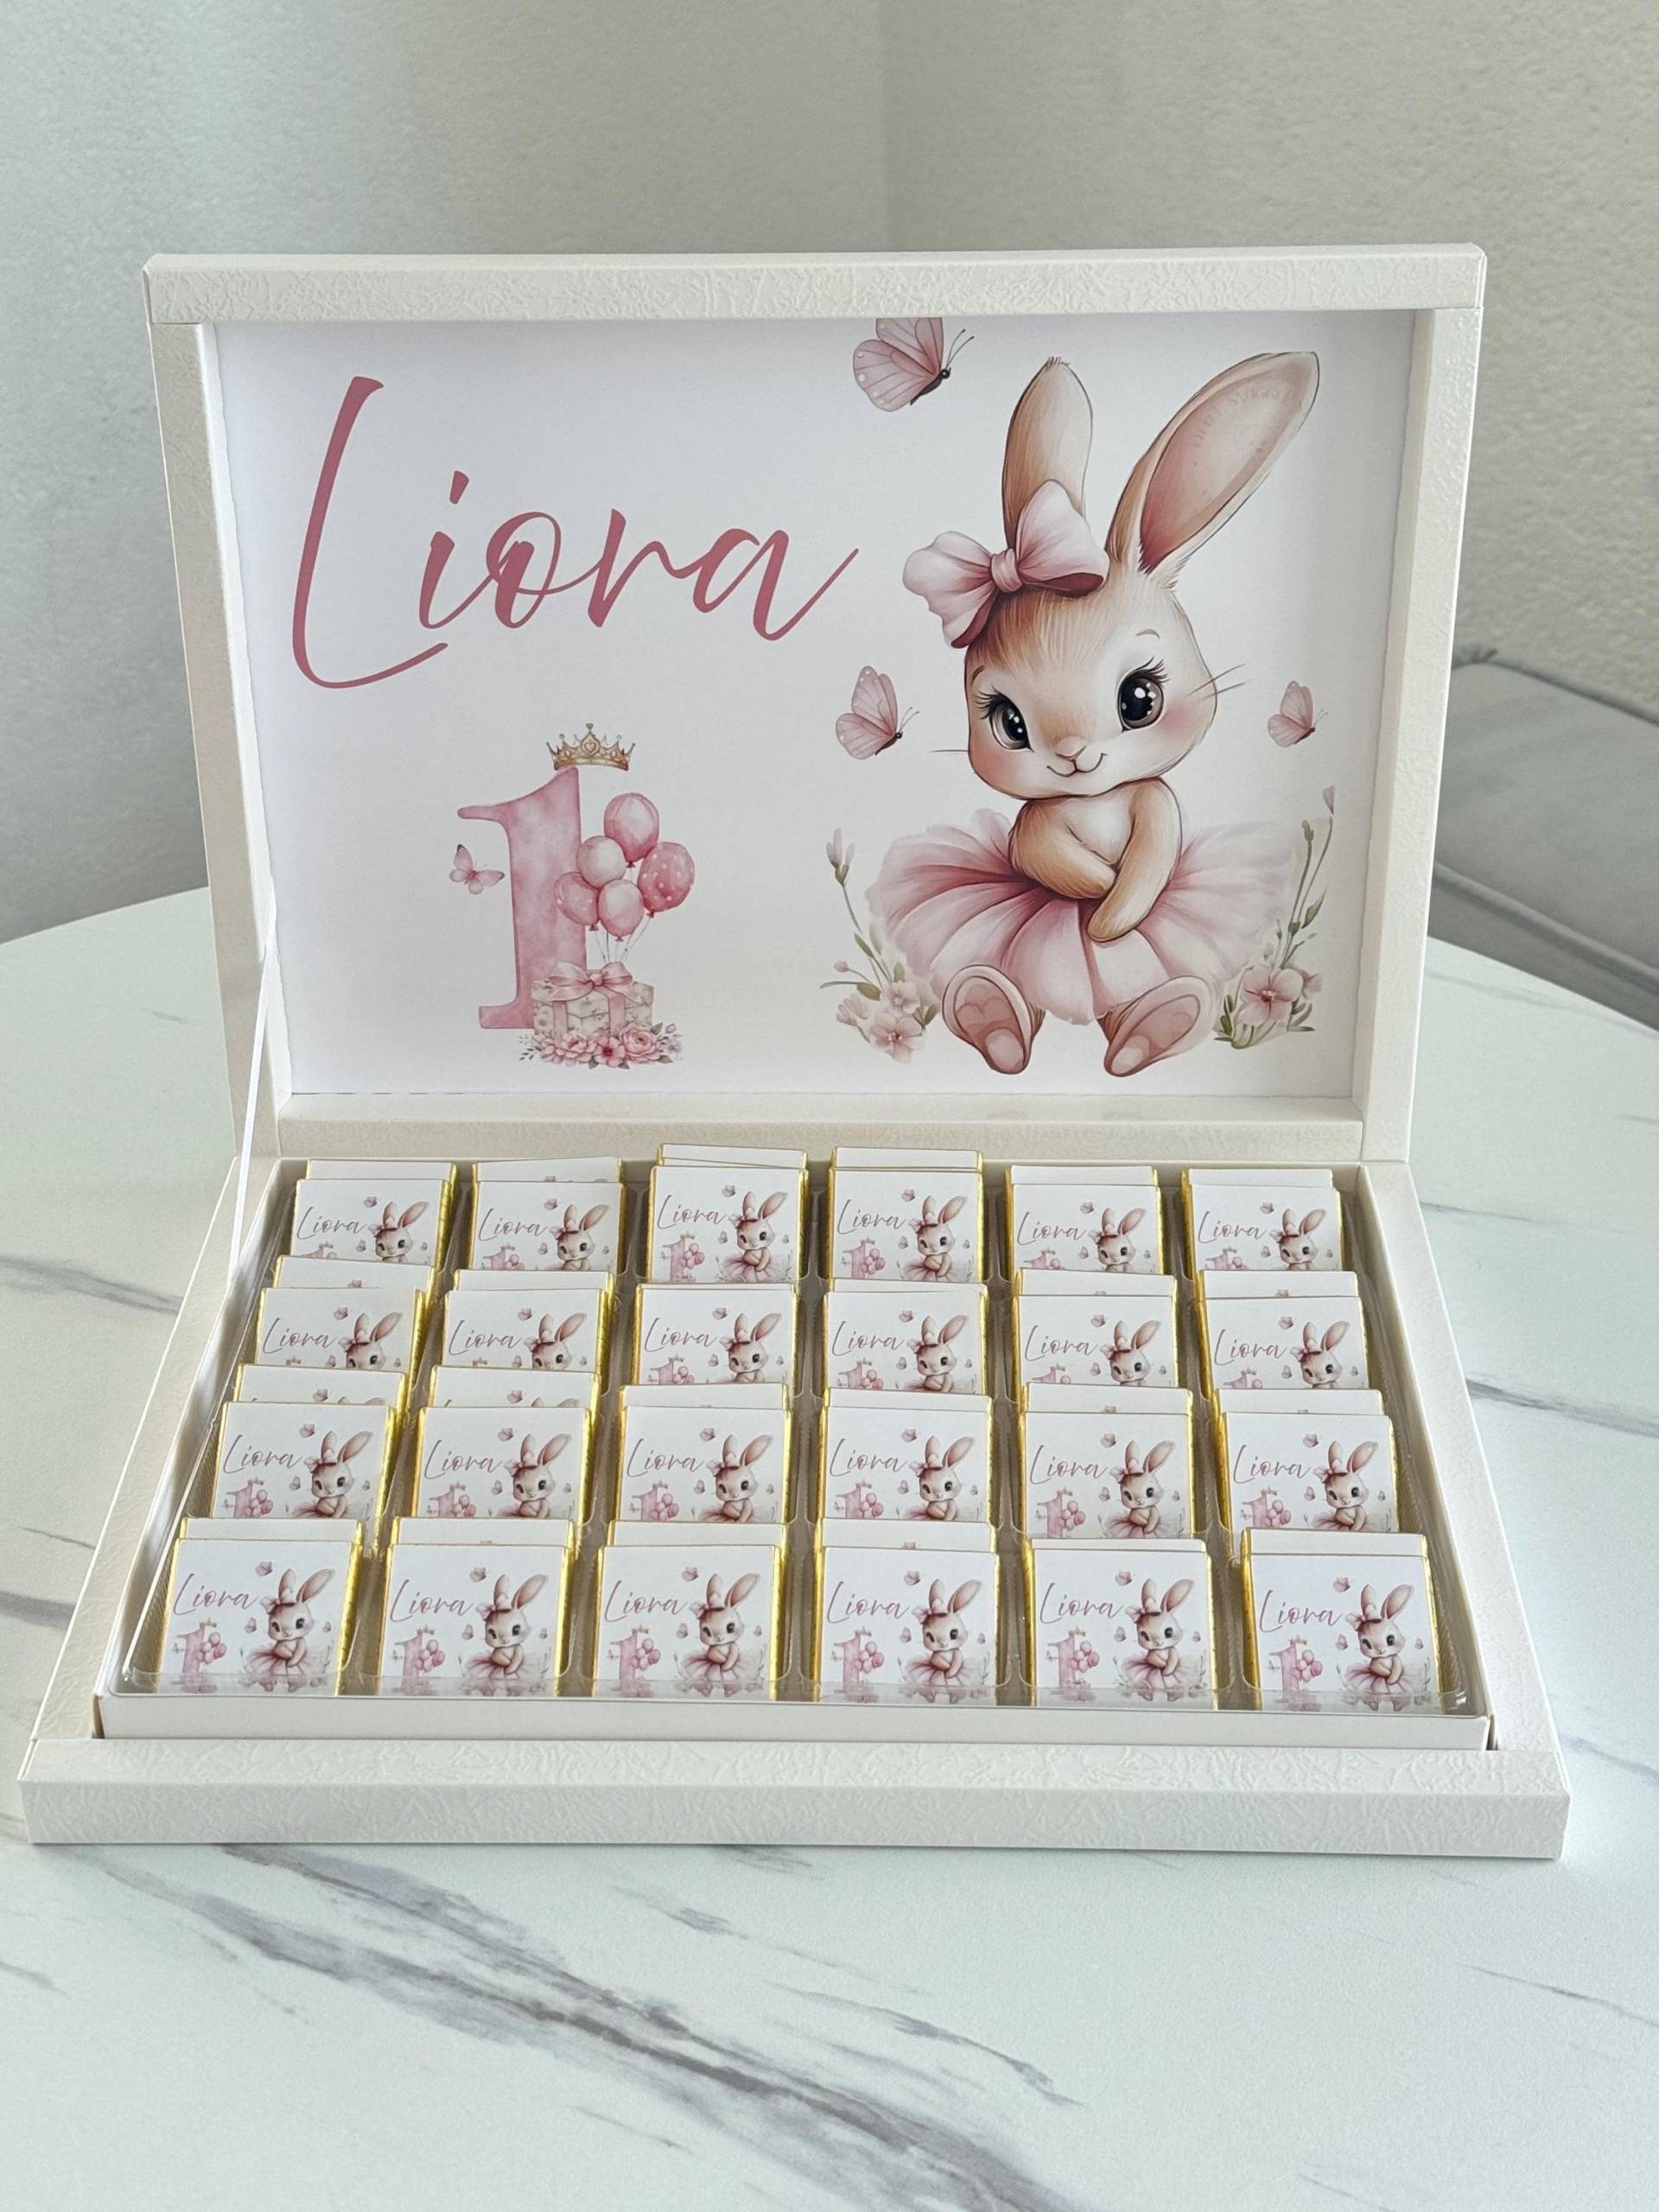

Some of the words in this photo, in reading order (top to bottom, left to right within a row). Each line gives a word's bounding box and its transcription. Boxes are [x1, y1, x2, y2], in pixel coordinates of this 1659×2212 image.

[293, 376, 859, 689] Liora
[297, 1207, 366, 1239] Liora
[478, 1209, 546, 1241] Liora
[658, 1194, 727, 1229] Liora
[837, 1199, 906, 1234] Liora
[1017, 1212, 1086, 1245] Liora
[1198, 1211, 1266, 1243] Liora
[263, 1318, 335, 1354] Liora
[449, 1320, 521, 1355] Liora
[645, 1318, 717, 1352] Liora
[832, 1321, 905, 1356] Liora
[1025, 1325, 1096, 1361] Liora
[1214, 1329, 1287, 1365] Liora
[224, 1434, 302, 1473] Liora
[424, 1440, 503, 1479] Liora
[627, 1438, 705, 1478] Liora
[830, 1438, 907, 1477] Liora
[1030, 1445, 1108, 1484] Liora
[1233, 1445, 1311, 1484] Liora
[174, 1573, 258, 1615] Liora
[391, 1580, 474, 1622] Liora
[605, 1580, 688, 1622] Liora
[827, 1581, 910, 1624] Liora
[1040, 1582, 1123, 1624] Liora
[1260, 1590, 1343, 1632] Liora
